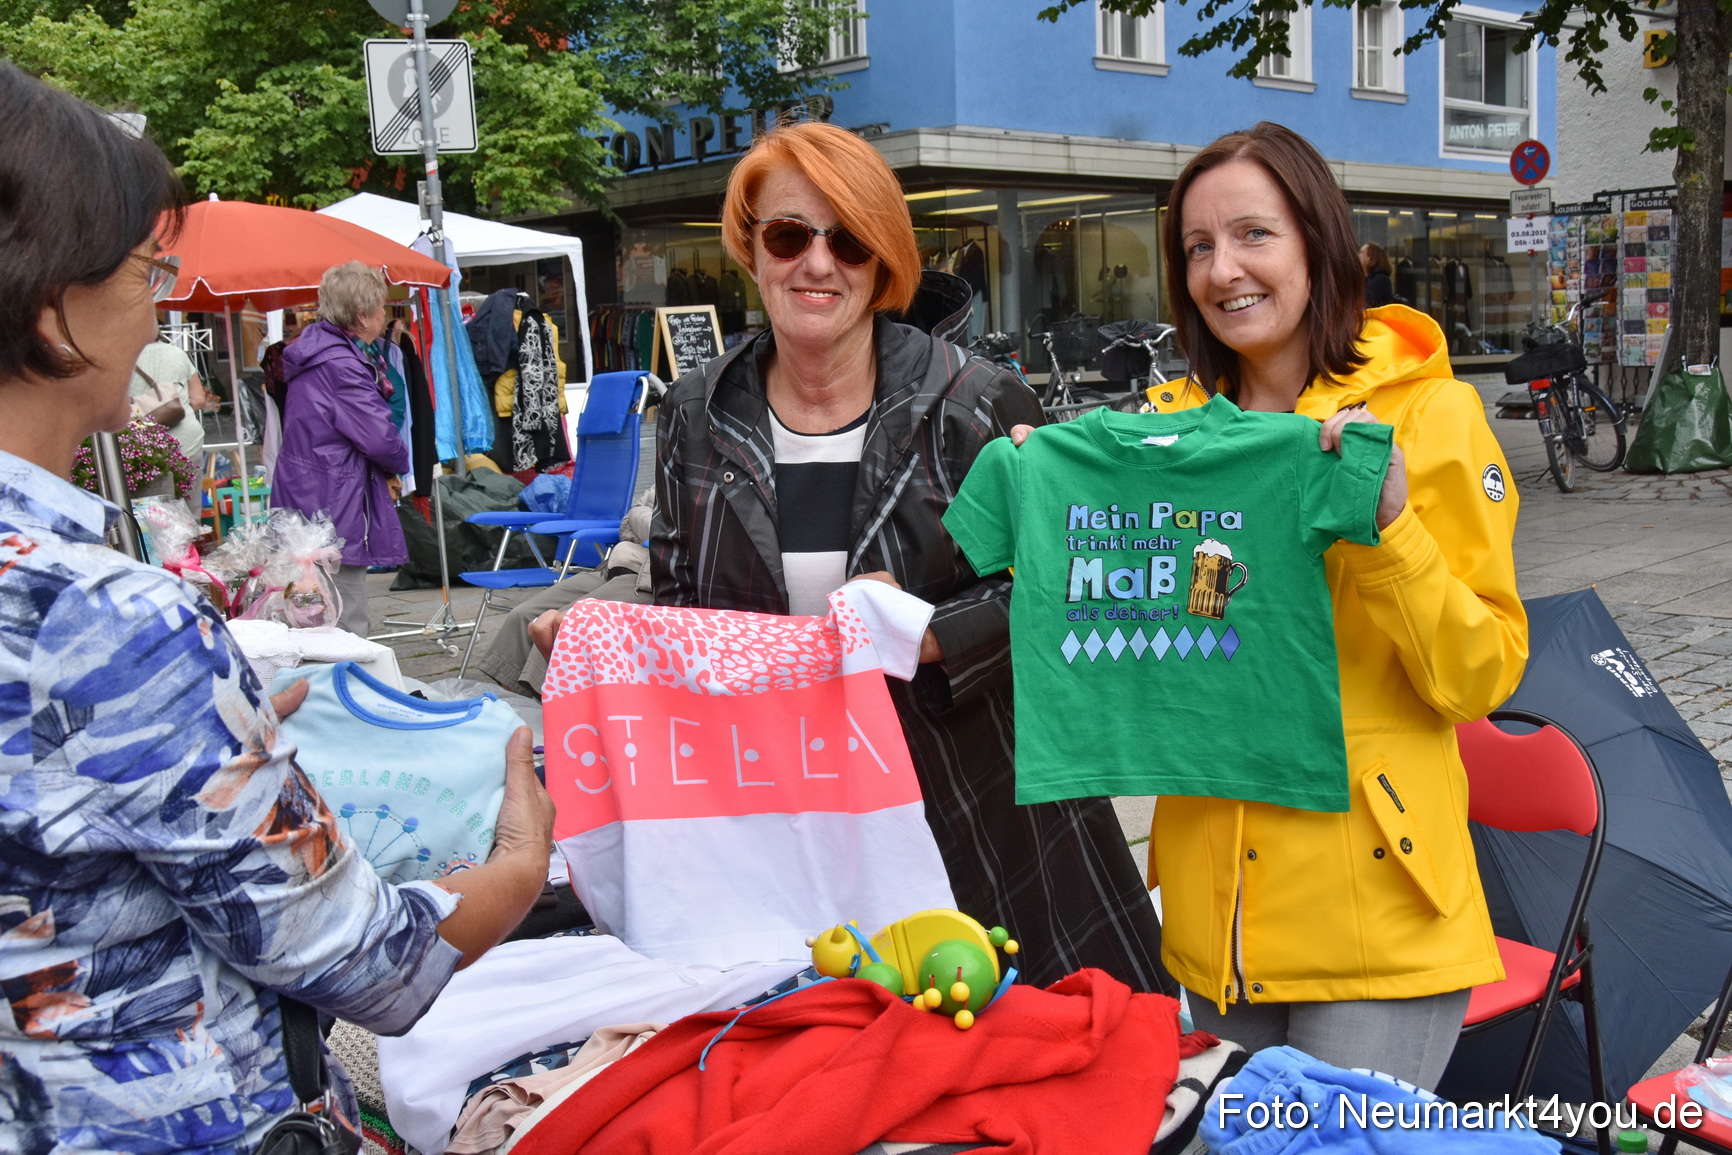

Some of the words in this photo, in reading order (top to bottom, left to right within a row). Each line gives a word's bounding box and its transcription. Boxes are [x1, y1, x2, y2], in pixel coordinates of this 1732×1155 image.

[401, 127, 451, 145] ZOE
[1449, 124, 1484, 140] ANTON
[1488, 122, 1521, 137] PETER
[1514, 191, 1546, 201] Feuerwehr-
[1630, 199, 1669, 208] GOLDBEK
[1521, 203, 1540, 211] zufahrt
[1066, 503, 1140, 531] Mein
[1149, 501, 1243, 536] Papa
[1066, 534, 1127, 551] trinkt
[1132, 534, 1182, 551] mehr
[1066, 604, 1100, 622] als
[1105, 603, 1180, 622] deiner!
